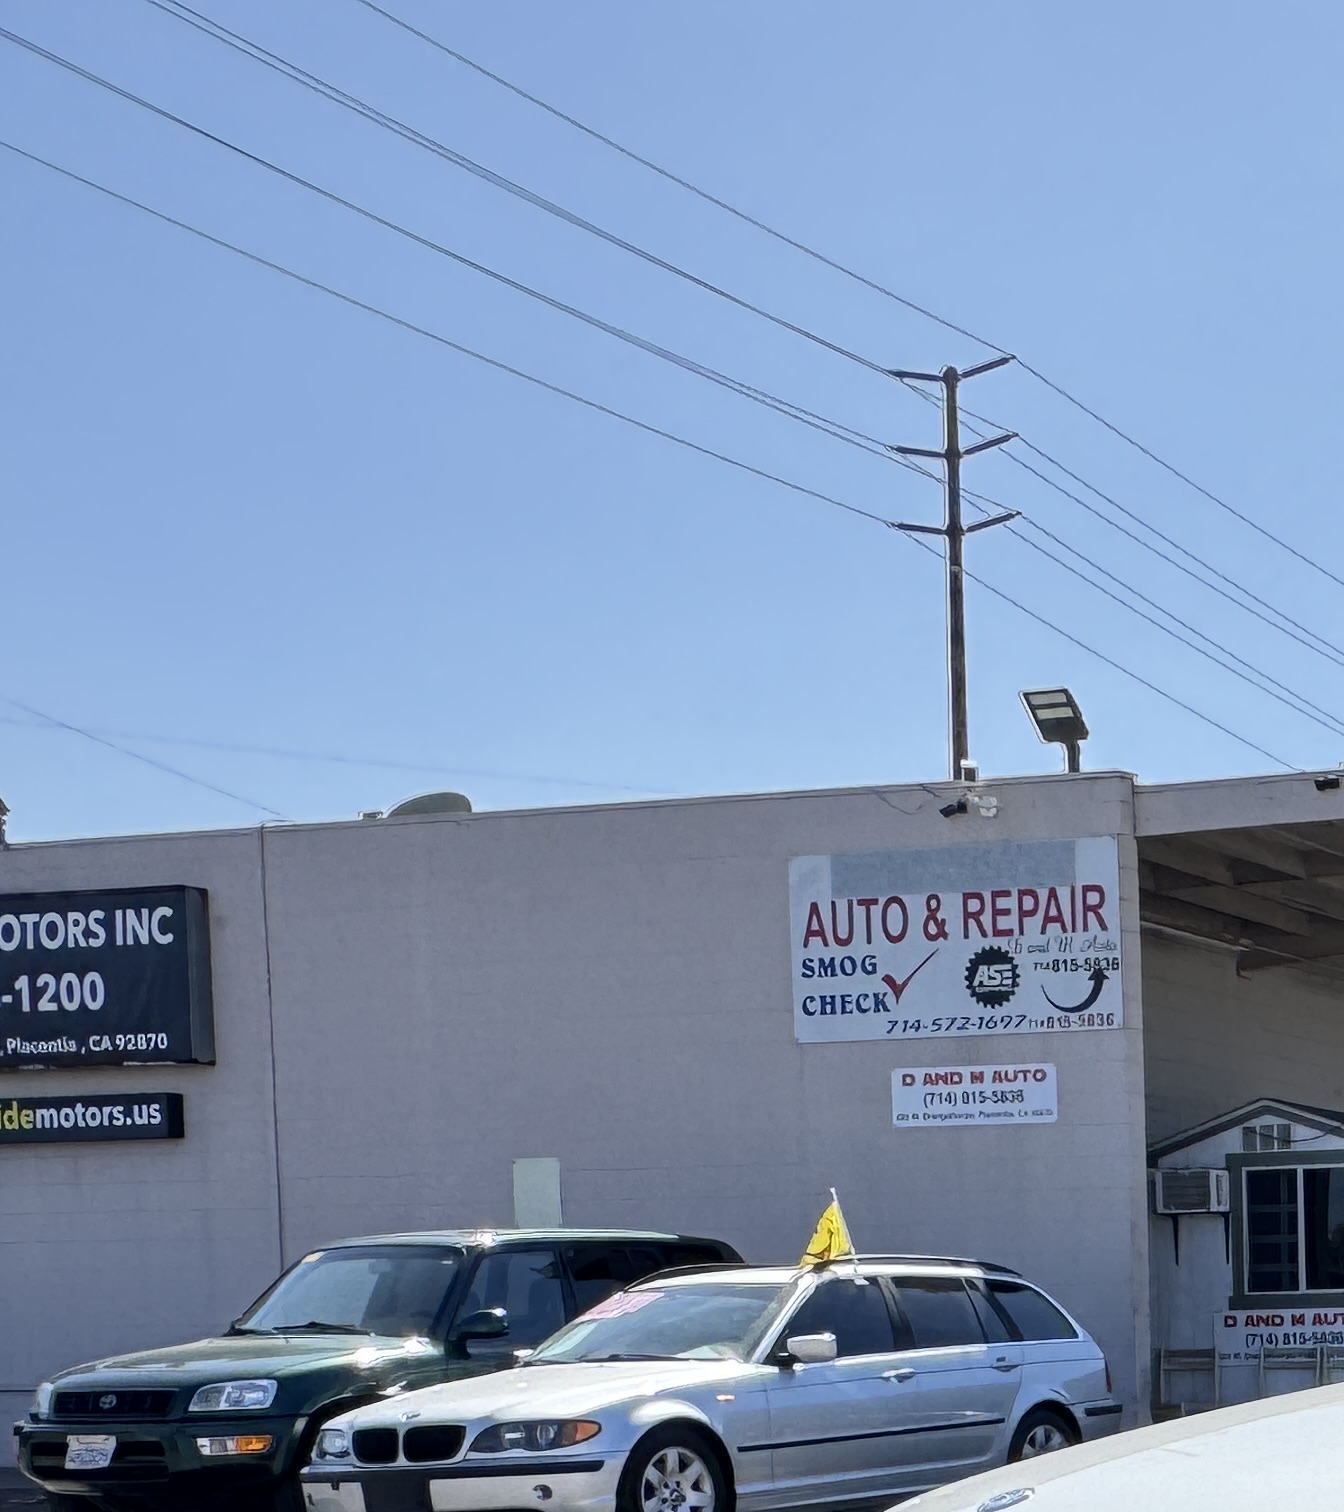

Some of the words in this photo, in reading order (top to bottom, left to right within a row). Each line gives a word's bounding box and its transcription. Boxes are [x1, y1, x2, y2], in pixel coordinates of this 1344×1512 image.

[115, 907, 174, 946] INC
[803, 896, 909, 948] AUTO
[922, 894, 949, 942] &
[962, 884, 1108, 940] REPAIR
[801, 955, 878, 979] SMOG
[1, 971, 105, 1012] -1200
[801, 992, 891, 1016] CHECK
[89, 1034, 113, 1051] CA
[902, 1073, 915, 1087] D
[923, 1072, 963, 1086] AND
[970, 1071, 984, 1084] M
[991, 1068, 1047, 1083] AUTO
[1224, 1315, 1237, 1328] D
[1244, 1314, 1285, 1328] AND
[1291, 1313, 1305, 1327] M
